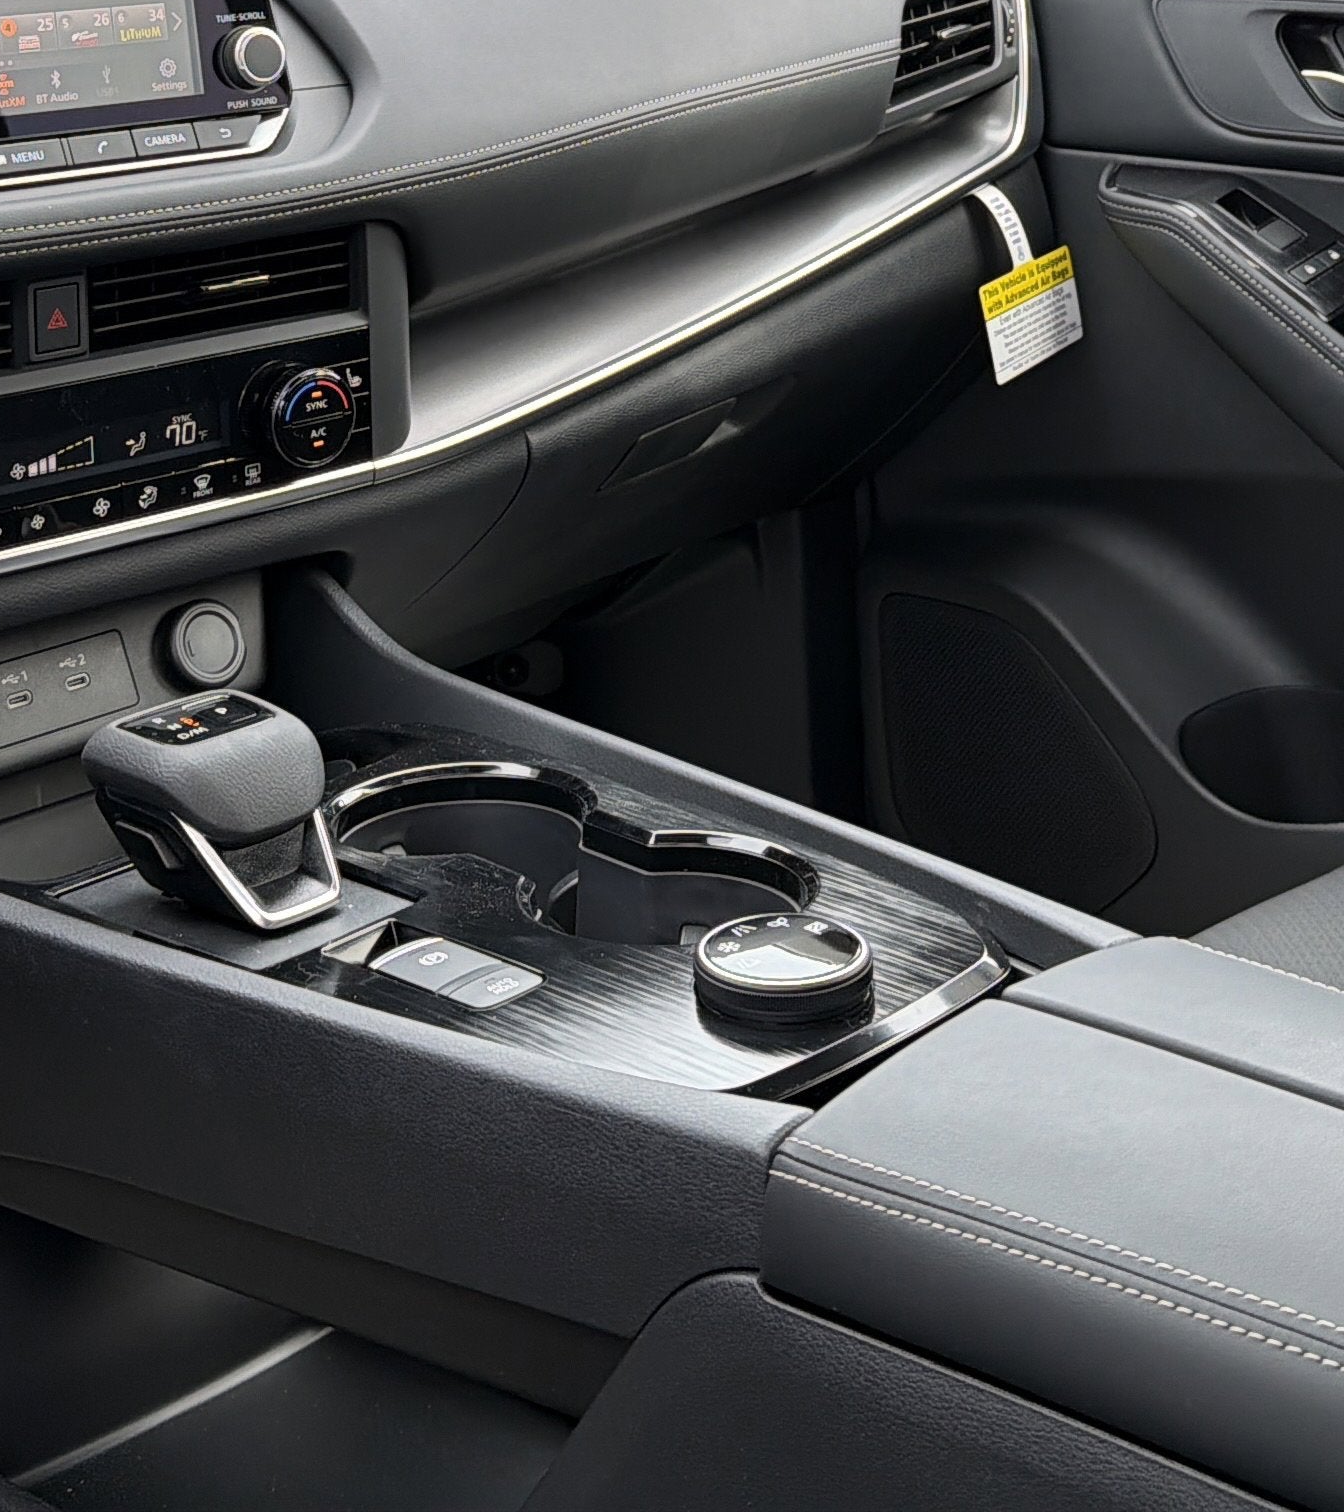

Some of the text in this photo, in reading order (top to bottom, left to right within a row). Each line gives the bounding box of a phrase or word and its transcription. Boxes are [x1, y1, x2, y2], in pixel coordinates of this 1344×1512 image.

[93, 13, 110, 27] 26
[117, 13, 125, 23] 6
[148, 9, 166, 22] 34
[37, 18, 54, 32] 25
[62, 18, 69, 29] 5
[151, 80, 187, 93] Settings
[36, 92, 79, 105] BT Audio
[227, 96, 278, 110] PUSH SOUND
[144, 133, 187, 148] CAMERA
[11, 150, 45, 164] MENU
[982, 285, 1000, 303] This
[1000, 270, 1027, 292] Vehicle
[987, 298, 1004, 315] with
[1005, 279, 1039, 305] Advanced
[305, 399, 329, 413] SYNC
[171, 412, 193, 424] SYNC
[310, 426, 327, 439] A/C
[192, 488, 214, 499] FRONT
